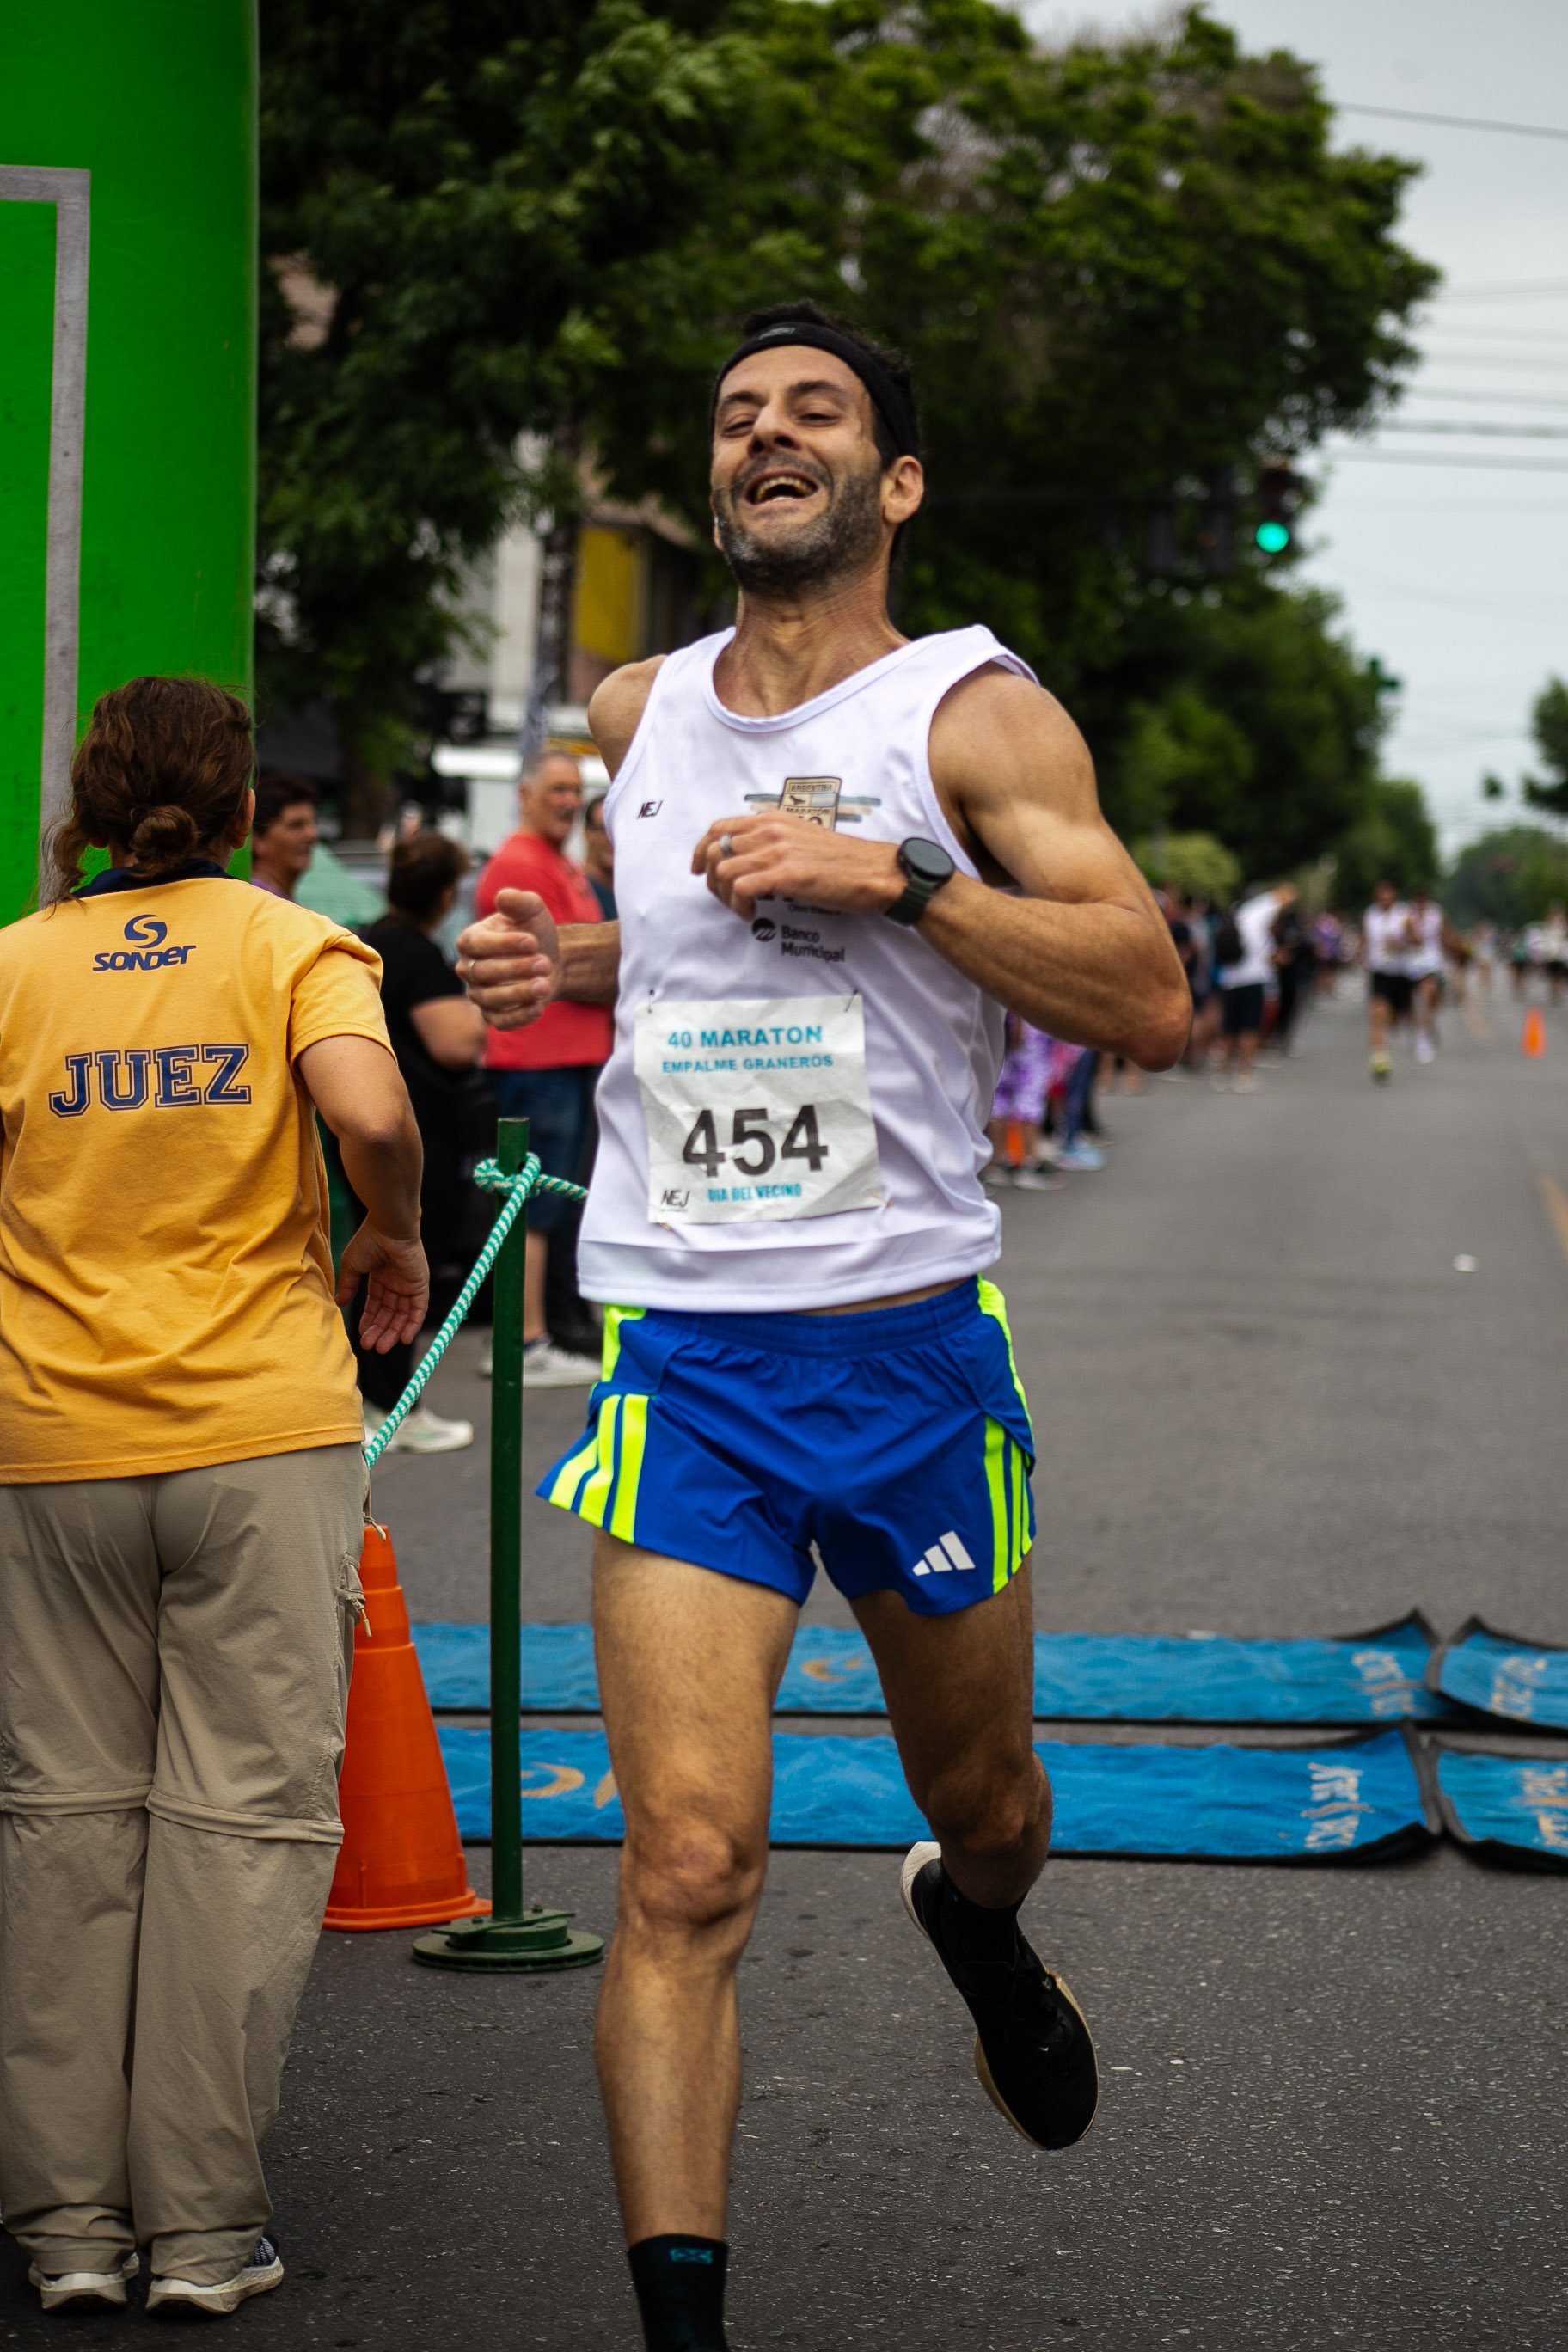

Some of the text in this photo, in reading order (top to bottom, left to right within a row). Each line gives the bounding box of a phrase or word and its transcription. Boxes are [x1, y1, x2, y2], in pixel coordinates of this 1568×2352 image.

[781, 925, 820, 943] Banco
[781, 941, 846, 963] Municipal
[667, 1026, 823, 1049] 40 MARATON
[662, 1055, 834, 1074] EMPALME GRANEROS
[48, 1043, 252, 1118] JUEZ
[683, 1104, 829, 1178] 454
[661, 1190, 690, 1207] NEJ
[707, 1182, 803, 1203] DIA DEL VECINO
